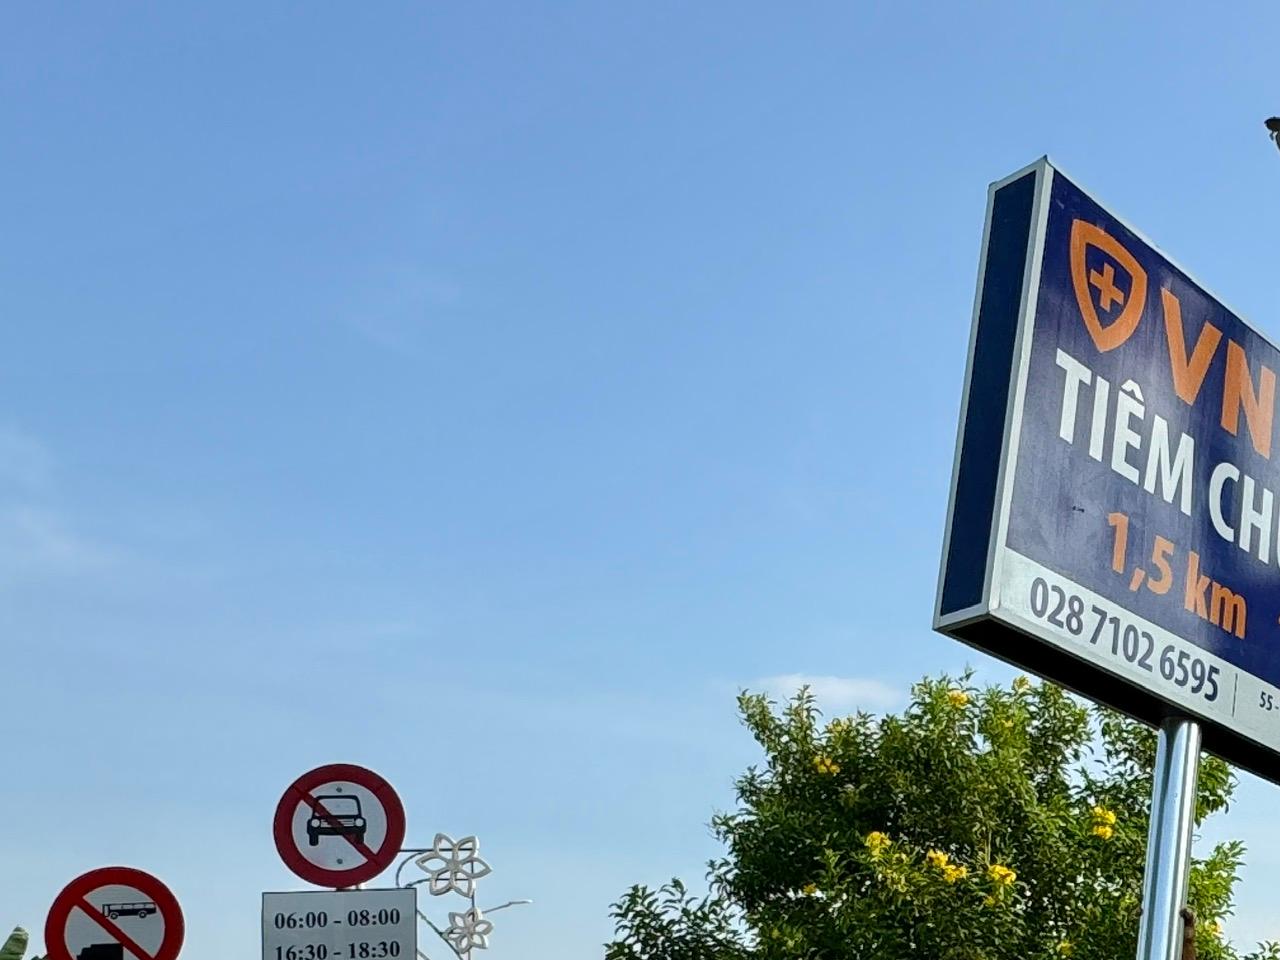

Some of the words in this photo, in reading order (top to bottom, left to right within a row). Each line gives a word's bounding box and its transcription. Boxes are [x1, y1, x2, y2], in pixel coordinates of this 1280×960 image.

[1055, 348, 1194, 516] TIÊM
[1108, 512, 1174, 594] 1,5
[1184, 551, 1247, 639] km
[1030, 577, 1084, 635] 028
[1089, 604, 1154, 673] 7102
[1159, 645, 1220, 702] 6595
[1259, 691, 1274, 711] 55
[274, 910, 328, 930] 06:00
[347, 907, 400, 927] 08:00
[348, 940, 400, 960] 18:30
